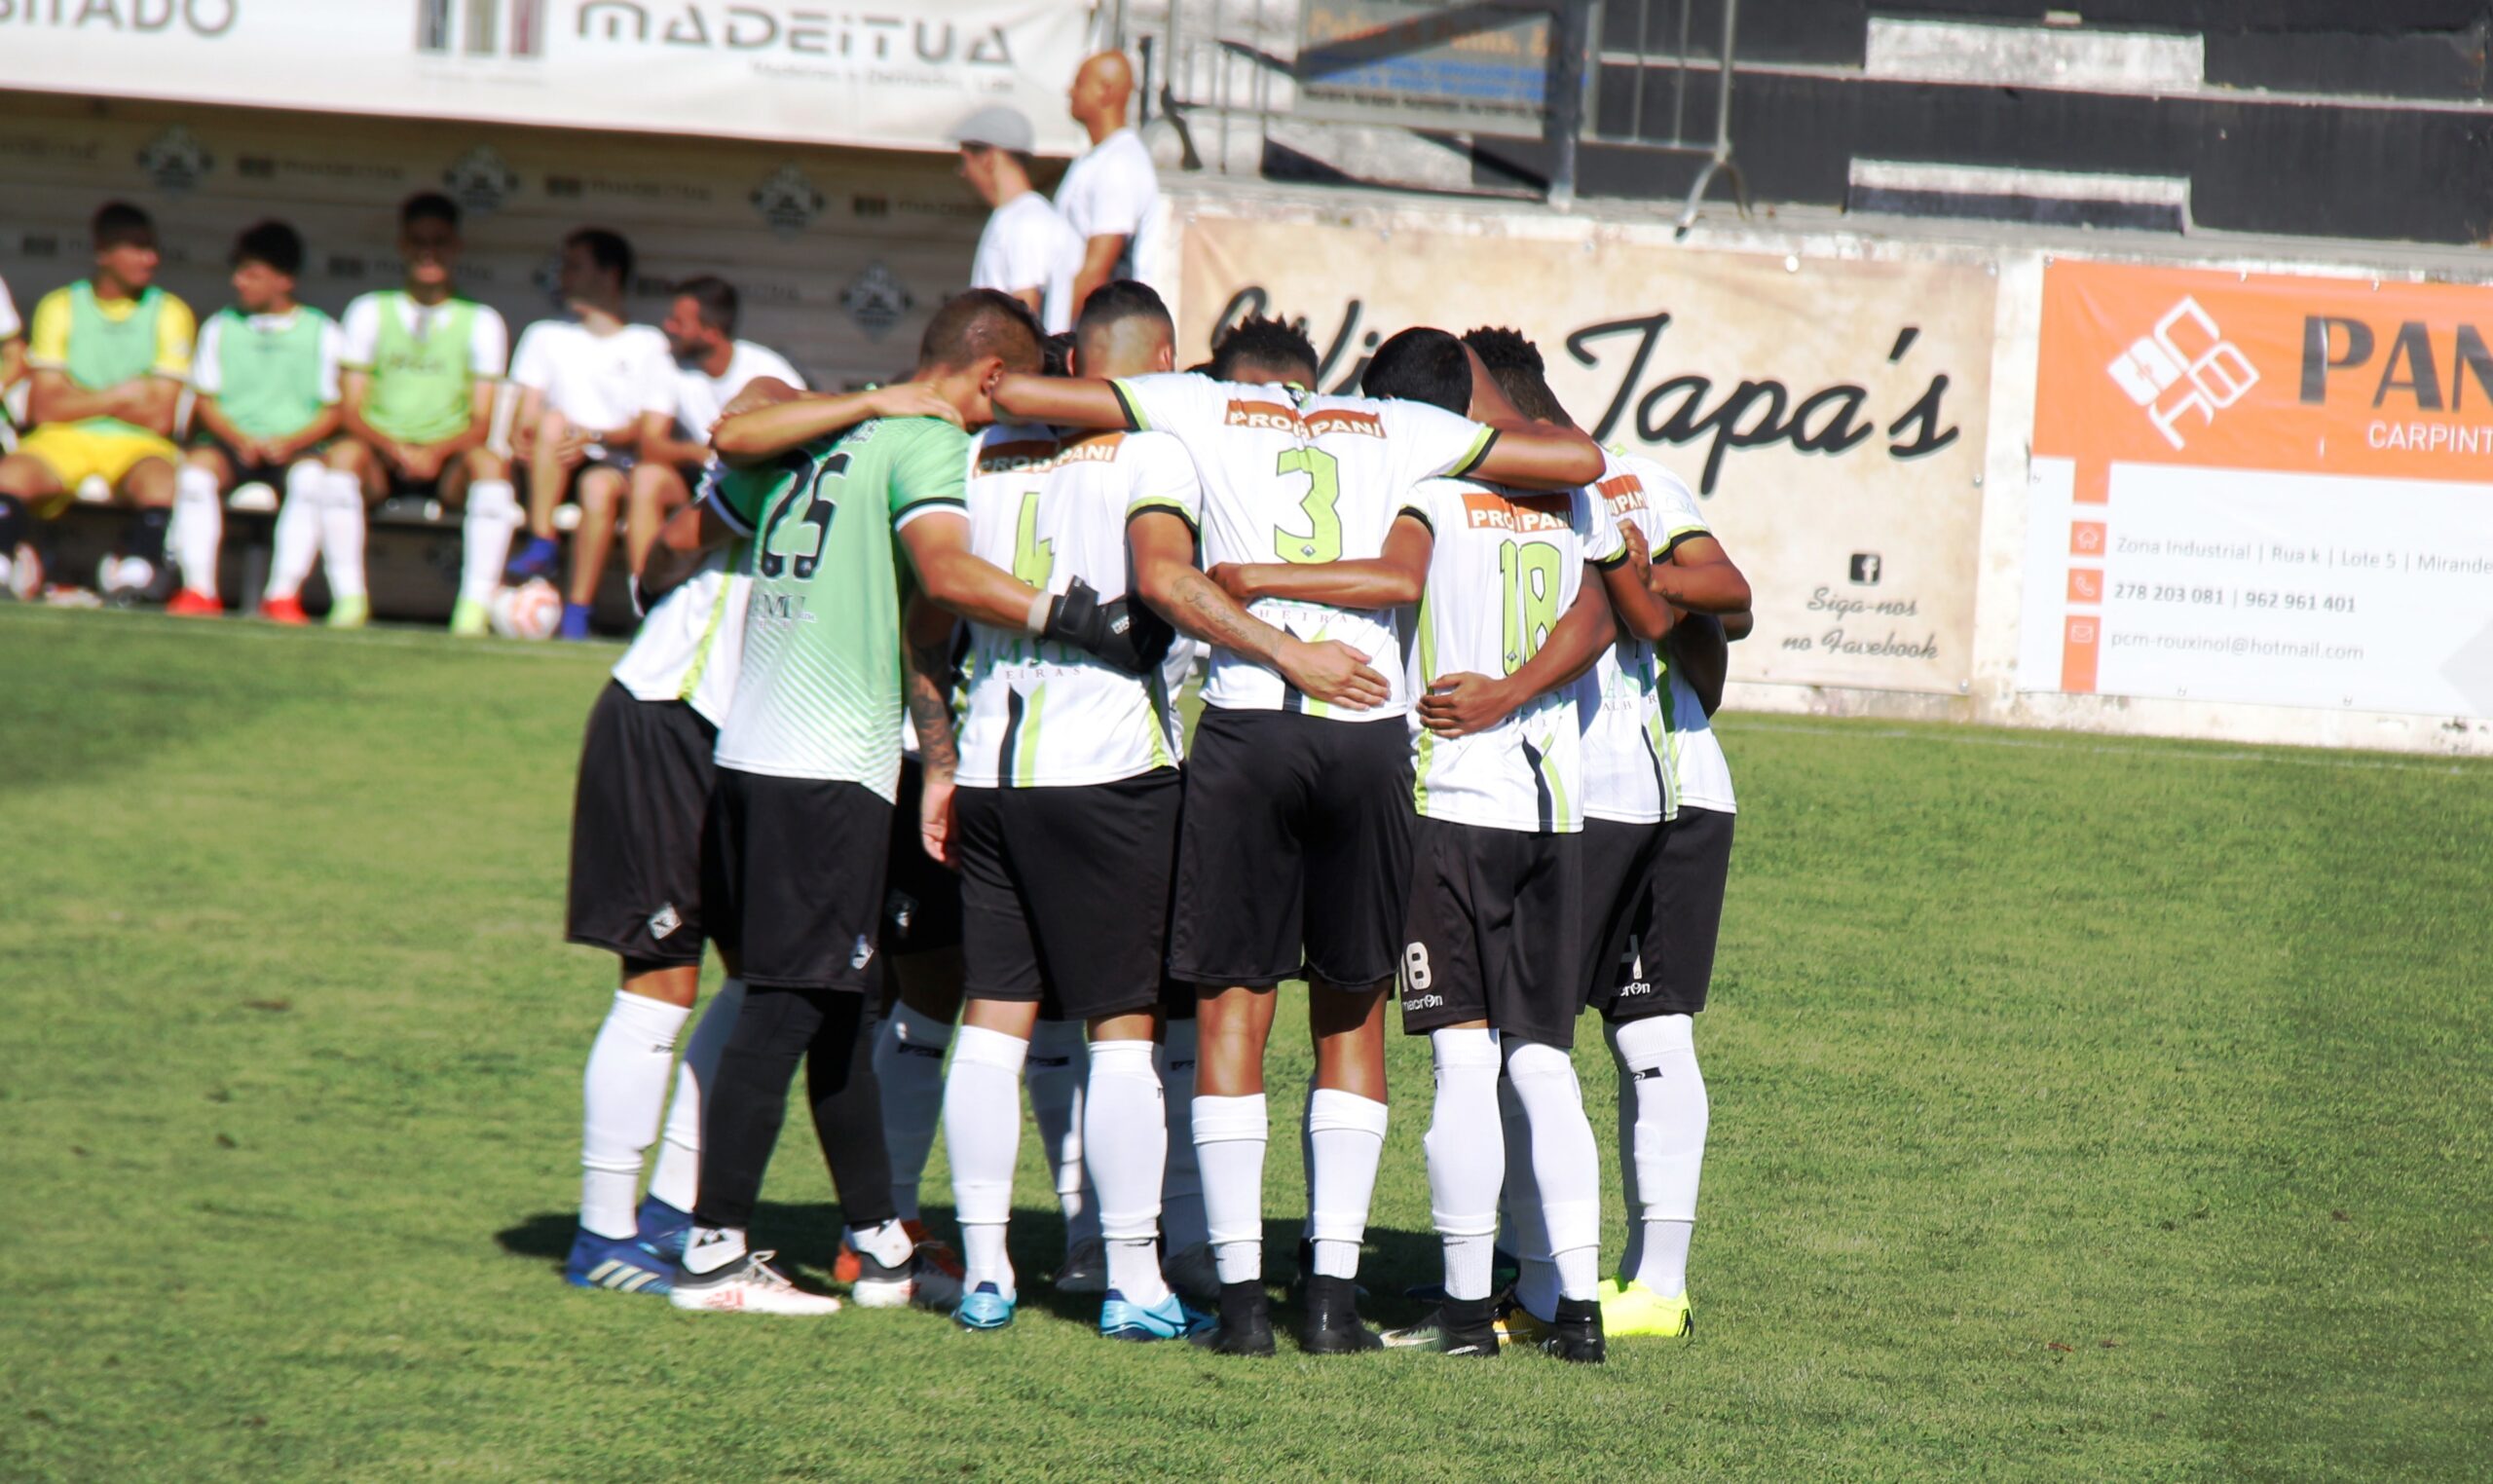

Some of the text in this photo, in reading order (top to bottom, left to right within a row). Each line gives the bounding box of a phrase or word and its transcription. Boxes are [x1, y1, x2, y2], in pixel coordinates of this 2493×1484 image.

[1566, 312, 1960, 496] Tapa's
[760, 447, 854, 581] 25
[1274, 446, 1343, 564] 3
[2116, 536, 2161, 555] Zona
[2166, 539, 2251, 561] Industrial
[2271, 545, 2309, 564] Rua
[2341, 551, 2381, 569] Lote
[2385, 552, 2397, 570] 5
[1500, 538, 1562, 677] 18
[1781, 628, 1940, 660] no Facebook
[2113, 583, 2357, 613] 278 203 081 962 961 401
